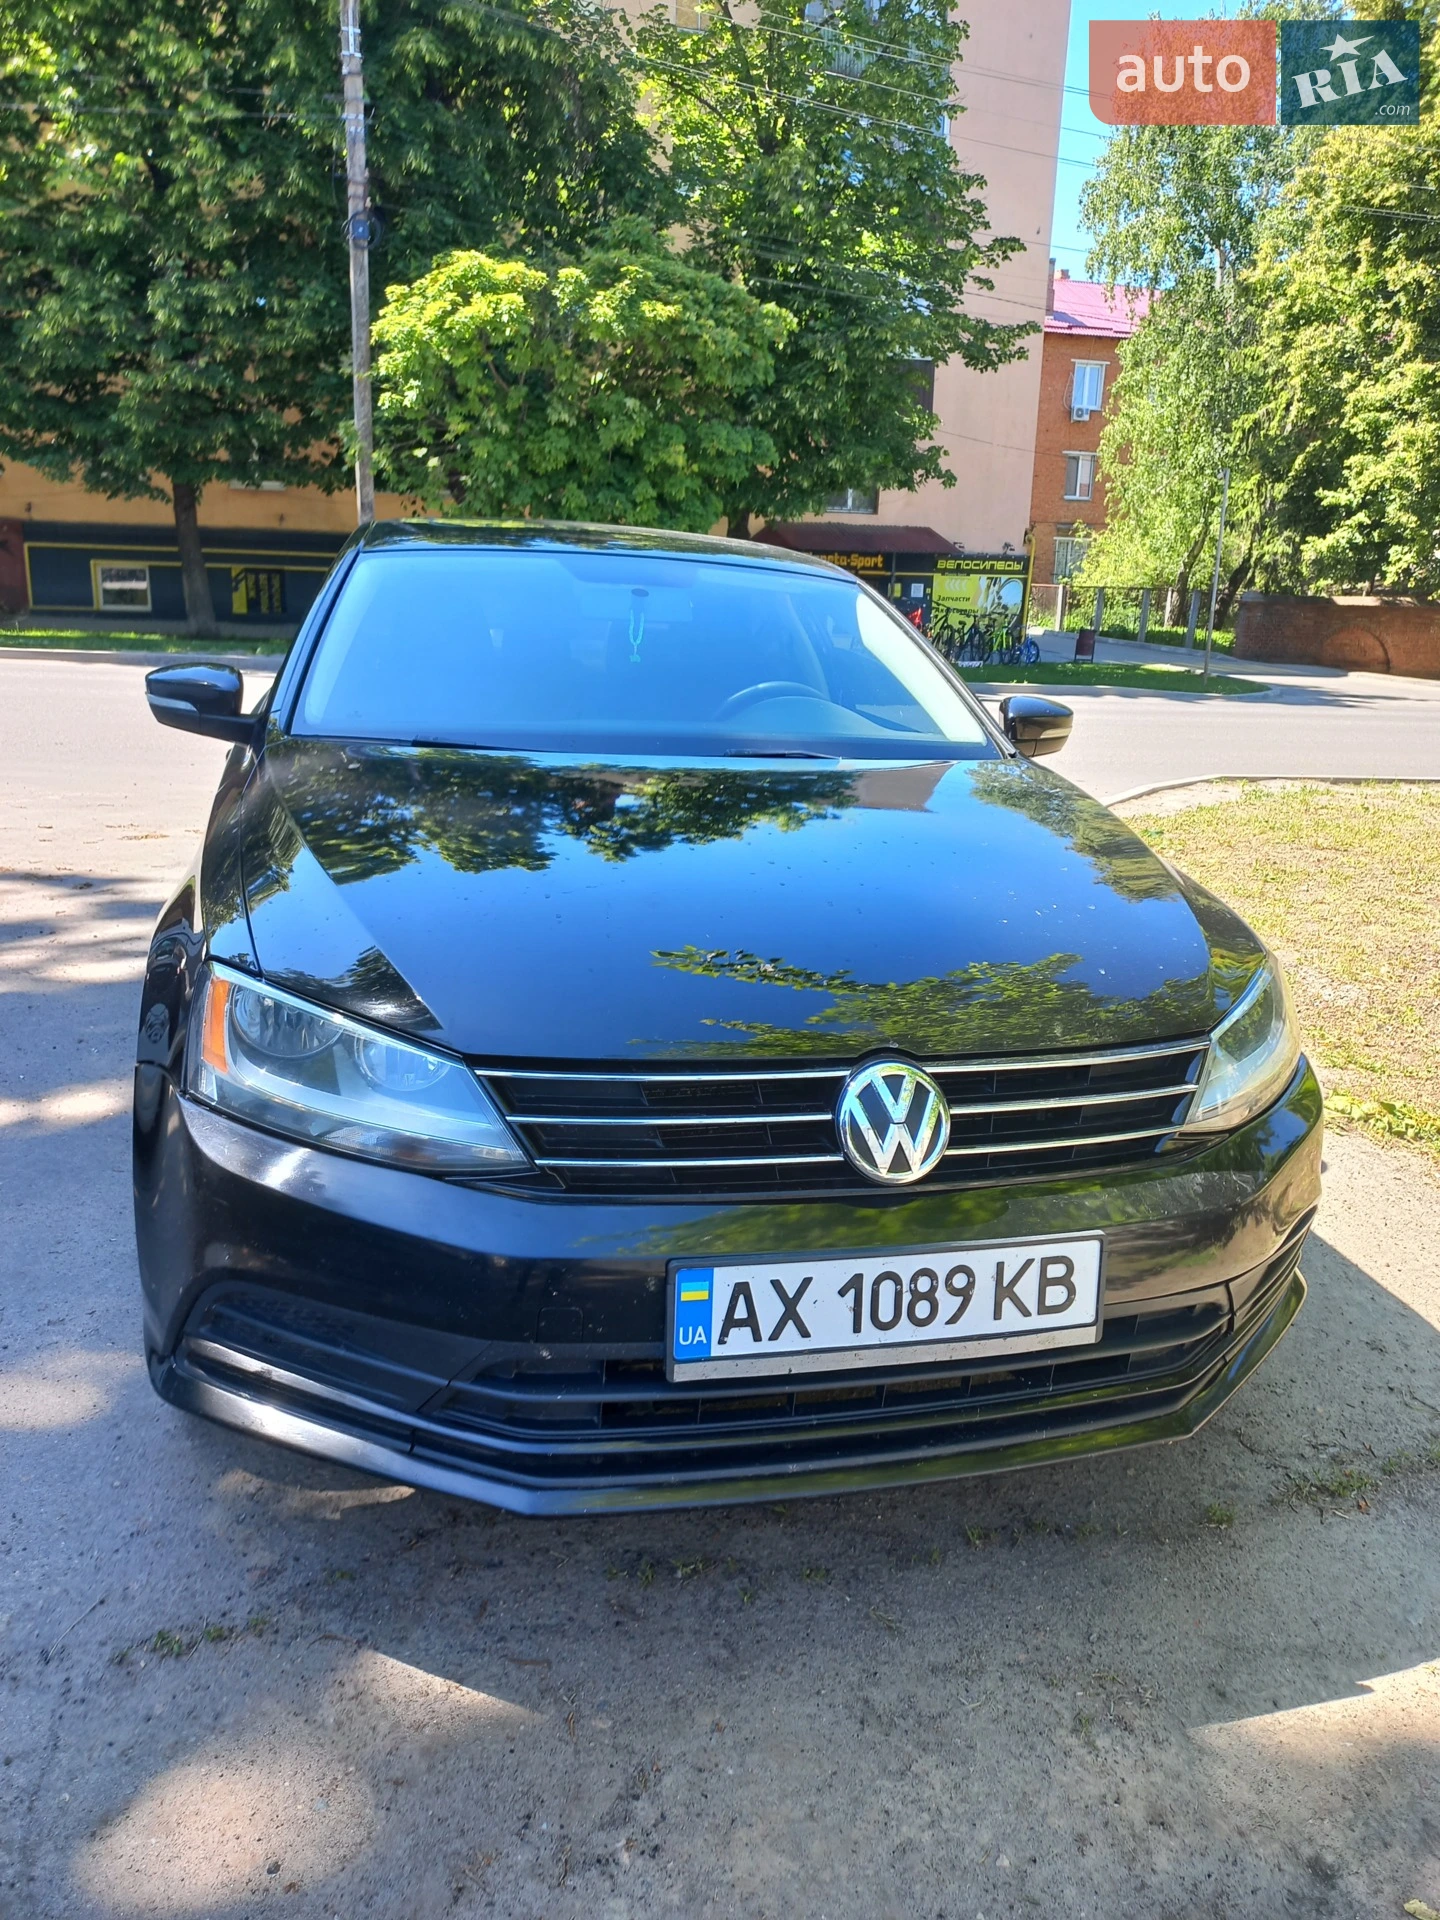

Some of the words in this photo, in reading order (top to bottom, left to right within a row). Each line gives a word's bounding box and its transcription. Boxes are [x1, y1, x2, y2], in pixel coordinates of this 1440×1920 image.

[937, 594, 971, 602] Запчасти
[840, 1063, 950, 1183] VW
[717, 1275, 814, 1346] AX
[837, 1264, 977, 1334] 1089
[993, 1255, 1077, 1321] KB
[678, 1325, 708, 1346] UA
